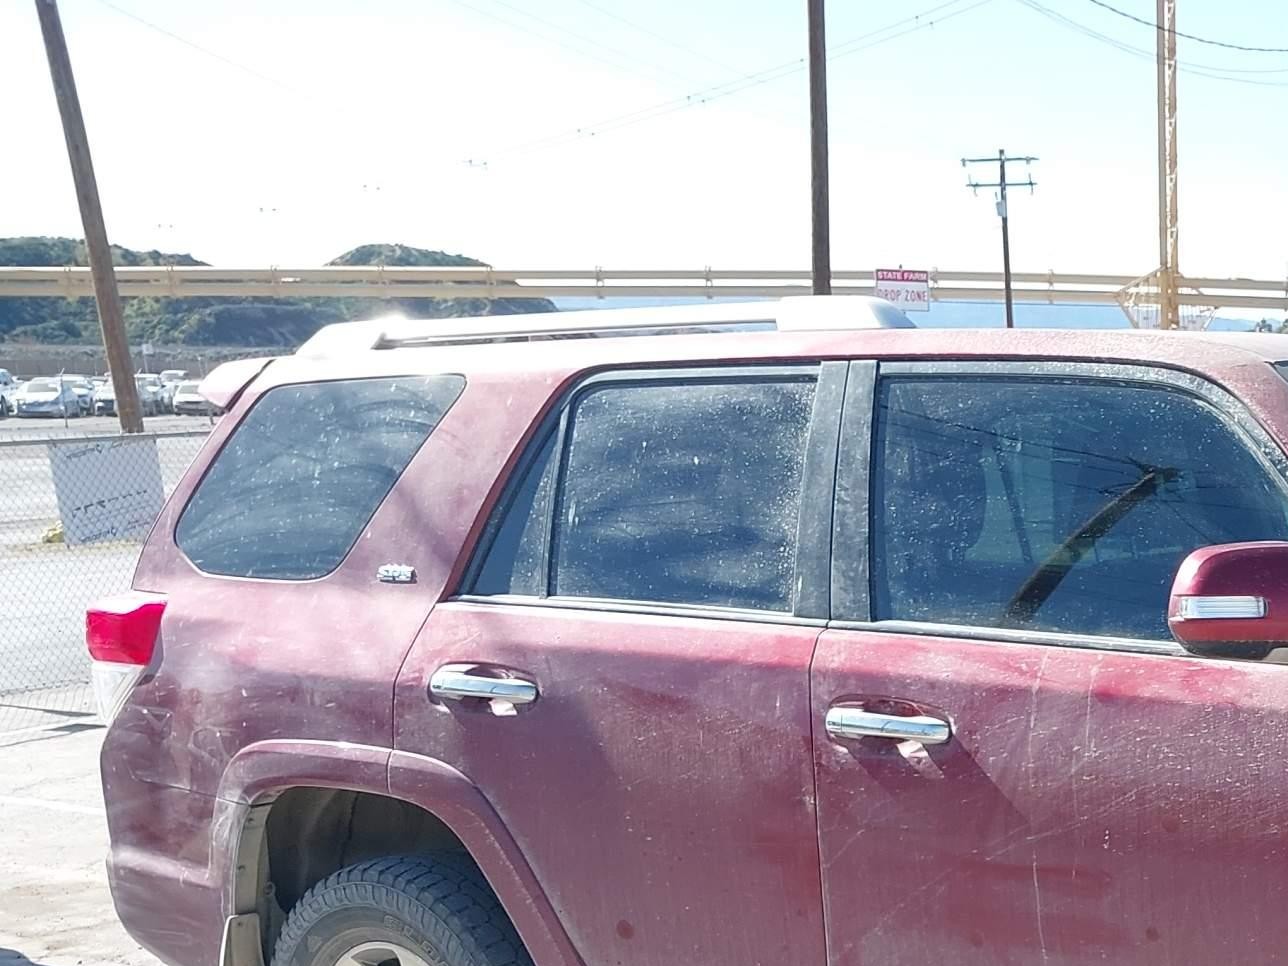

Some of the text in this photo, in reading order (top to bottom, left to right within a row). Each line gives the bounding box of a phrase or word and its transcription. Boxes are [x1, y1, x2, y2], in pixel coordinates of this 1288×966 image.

[878, 271, 927, 281] STATE FARM
[878, 289, 927, 302] DROP ZONE
